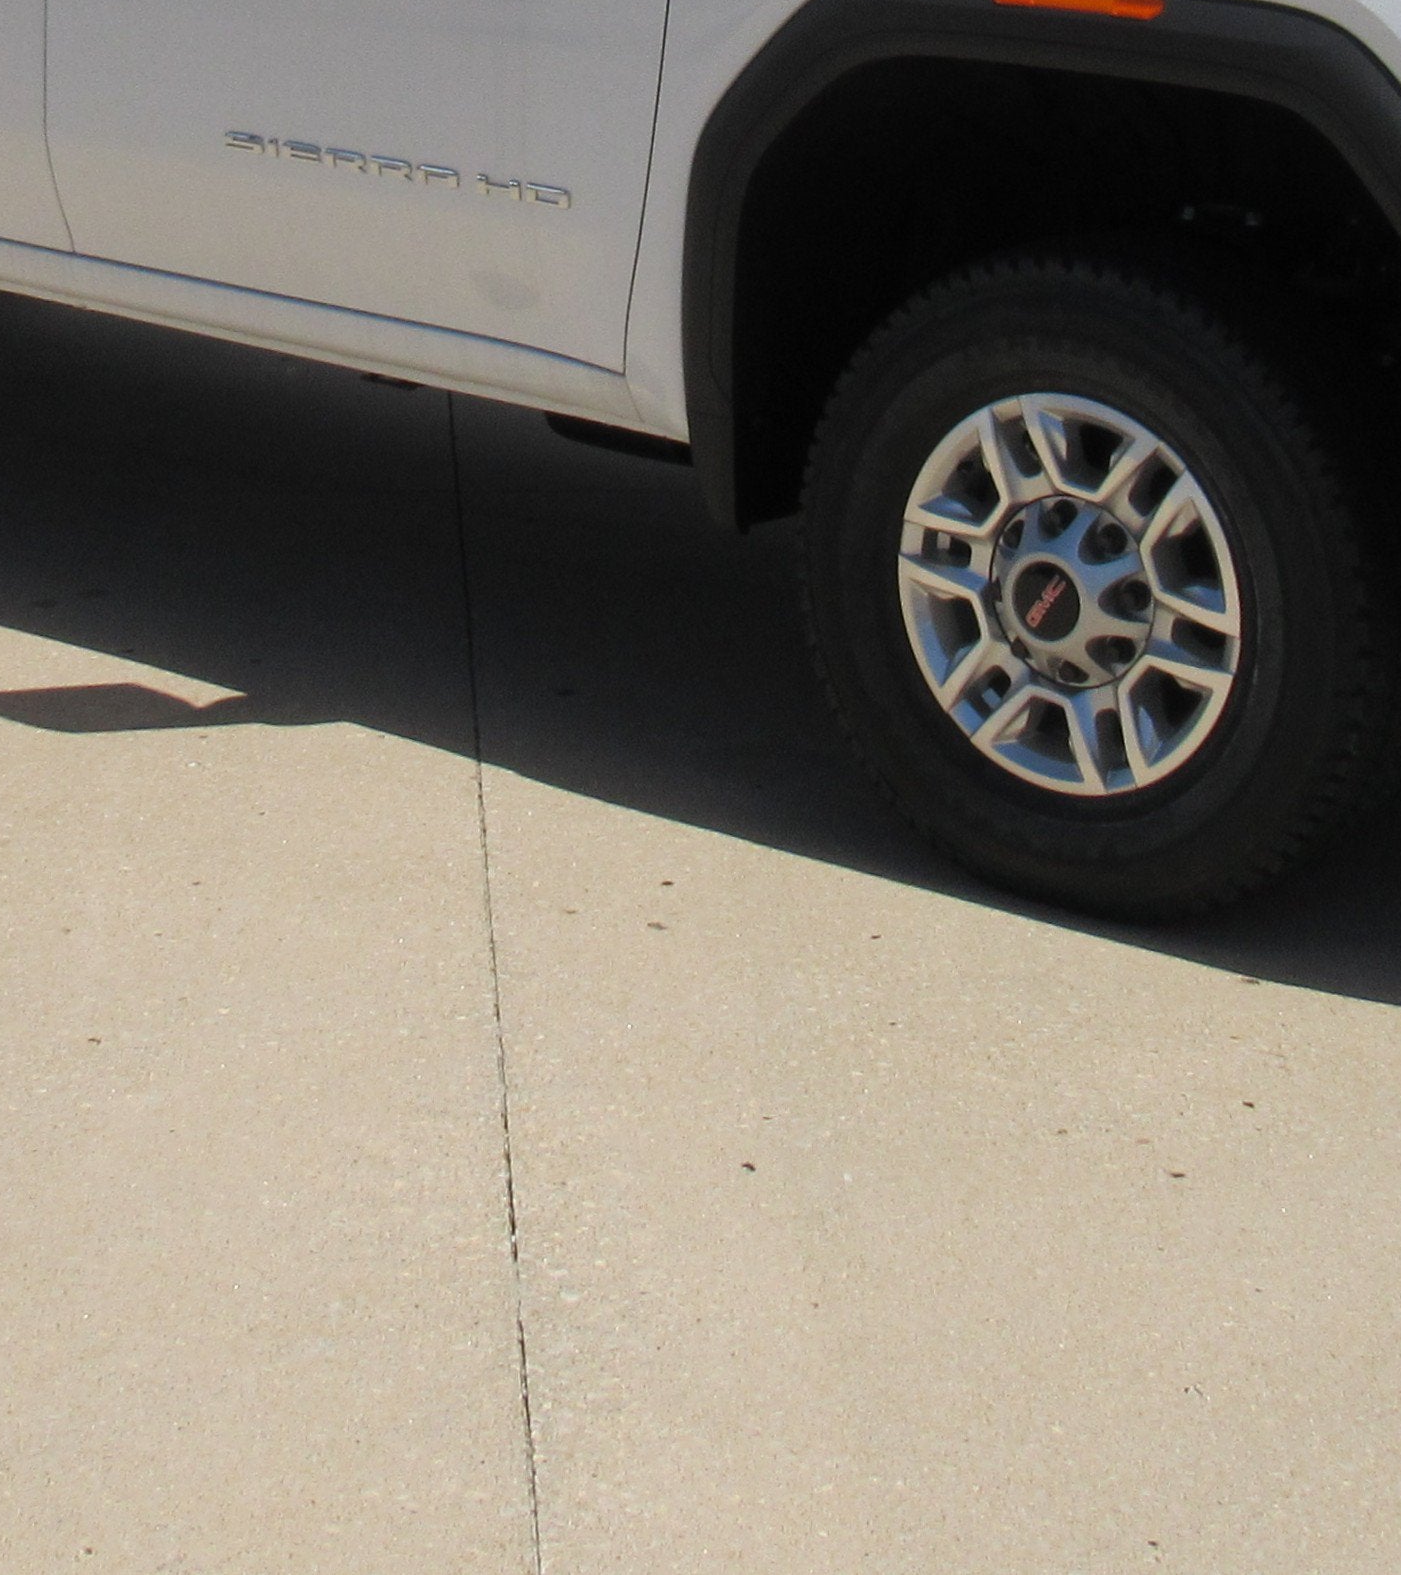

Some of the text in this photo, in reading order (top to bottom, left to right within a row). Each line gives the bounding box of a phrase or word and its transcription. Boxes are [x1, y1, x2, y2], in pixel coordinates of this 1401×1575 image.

[224, 129, 571, 210] SIERRA HD
[1025, 574, 1067, 628] GMC
